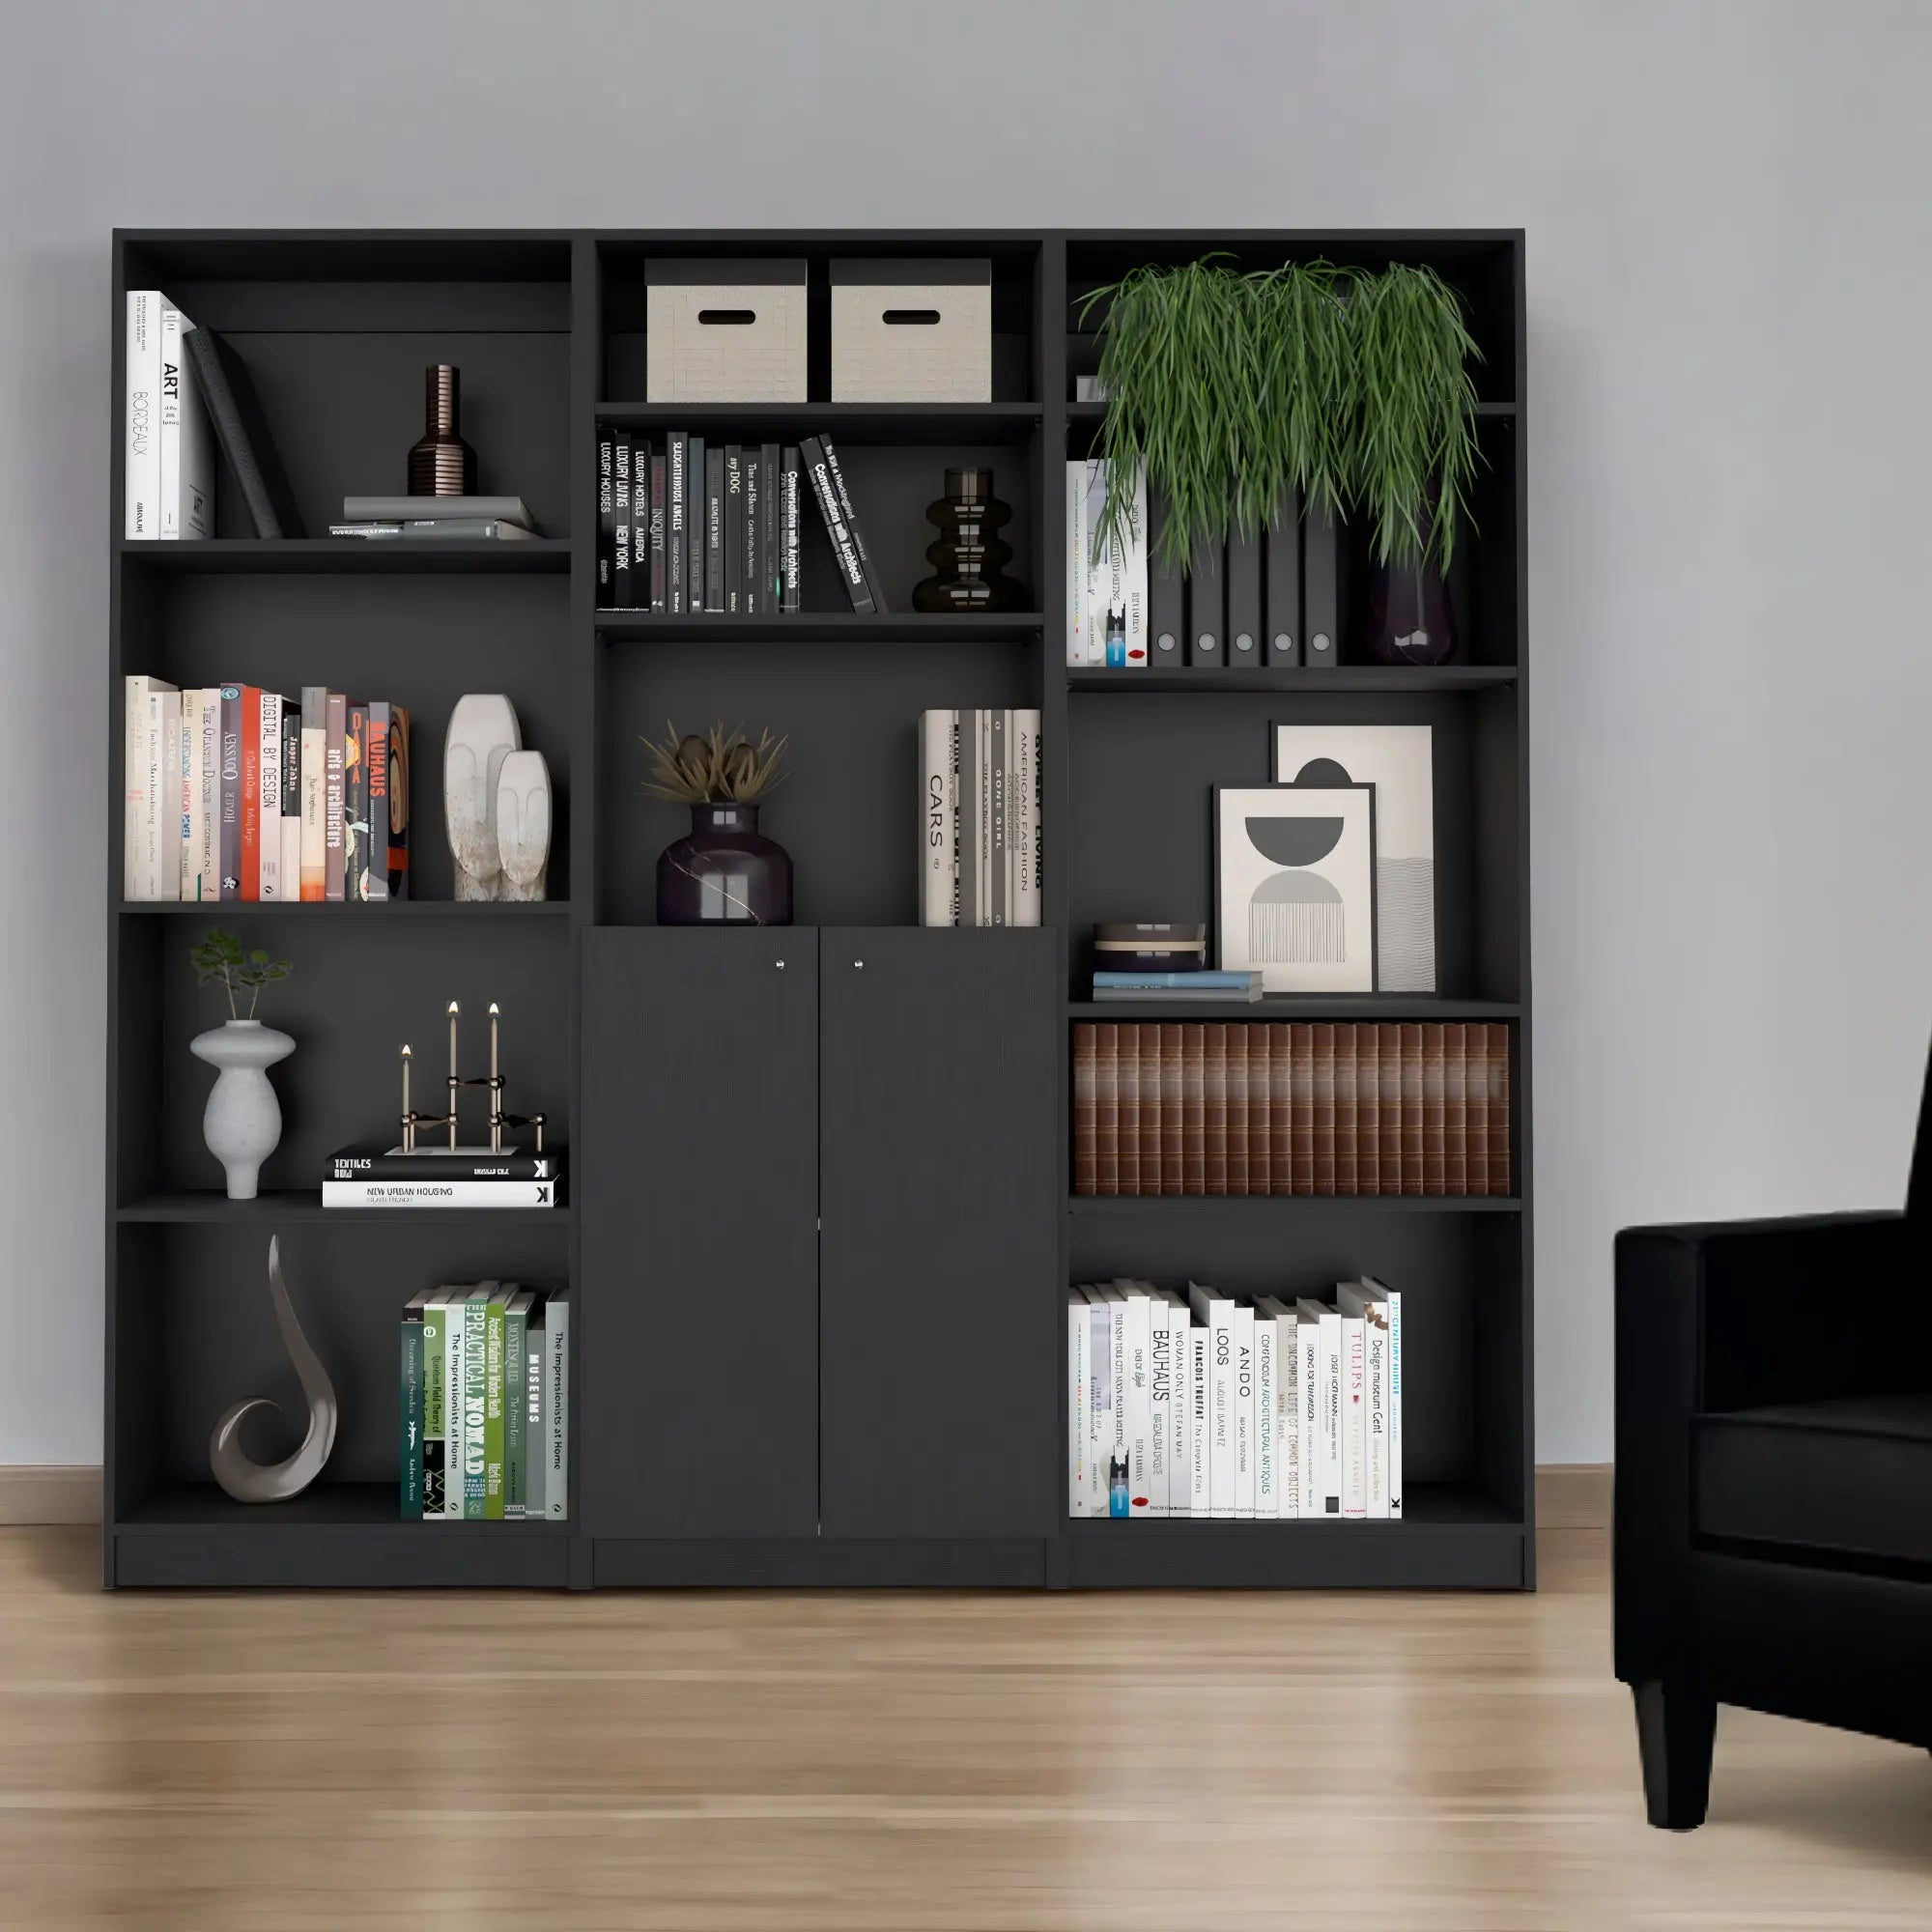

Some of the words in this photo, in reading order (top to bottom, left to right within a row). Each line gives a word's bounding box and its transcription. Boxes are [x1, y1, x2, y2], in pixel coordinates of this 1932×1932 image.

[164, 363, 178, 399] ART
[133, 391, 148, 456] BORDEAUX
[600, 441, 611, 476] LUXURY
[615, 445, 629, 479] LUXURY
[600, 477, 611, 513] HOUSES
[615, 480, 629, 507] LIVING
[635, 484, 644, 517] HOTELS
[729, 471, 740, 495] DOG
[787, 470, 798, 528] Conversations
[814, 463, 841, 524] Conversations
[615, 525, 629, 545] NEW
[672, 504, 682, 531] ANGELS
[834, 522, 849, 542] with
[635, 526, 644, 563] AMERICA
[788, 529, 798, 547] with
[615, 546, 629, 570] YORK
[788, 548, 798, 588] Architects
[839, 542, 863, 585] Architects
[263, 696, 276, 740] DIGITAL
[222, 731, 239, 781] ODYSSEY
[263, 748, 276, 759] BY
[327, 749, 342, 769] arts
[370, 722, 385, 797] BAUHAUS
[263, 767, 276, 809] DESIGN
[327, 785, 343, 847] architecture
[930, 775, 943, 847] CARS
[451, 1333, 461, 1350] The
[554, 1332, 563, 1350] The
[1216, 1328, 1229, 1366] LOOS
[1289, 1323, 1297, 1338] THE
[465, 1312, 486, 1394] PRACTICAL
[1152, 1330, 1169, 1401] BAUHAUS
[1175, 1331, 1183, 1369] WOMAN
[1195, 1341, 1204, 1381] FRANCOIS
[1289, 1344, 1297, 1387] UNCOMMON
[1351, 1332, 1362, 1389] TULIPS
[1370, 1340, 1382, 1370] Design
[450, 1353, 460, 1425] Impressionists
[528, 1354, 539, 1423] MUSEUMS
[554, 1352, 563, 1425] Impressionists
[1175, 1374, 1183, 1400] ONLY
[1239, 1347, 1250, 1398] ANDO
[1289, 1392, 1297, 1413] LIFE
[1373, 1373, 1381, 1409] museum
[450, 1428, 460, 1438] at
[465, 1396, 486, 1475] NOMAD
[554, 1428, 561, 1438] at
[1262, 1389, 1270, 1452] ARCHITECTURAL
[1289, 1418, 1298, 1428] OF
[1373, 1412, 1382, 1434] Gent
[450, 1441, 460, 1469] Home
[554, 1441, 562, 1470] Home
[1289, 1435, 1298, 1465] COMMON
[1261, 1455, 1270, 1494] ANTIQUES
[1289, 1471, 1298, 1509] OBJECTS
